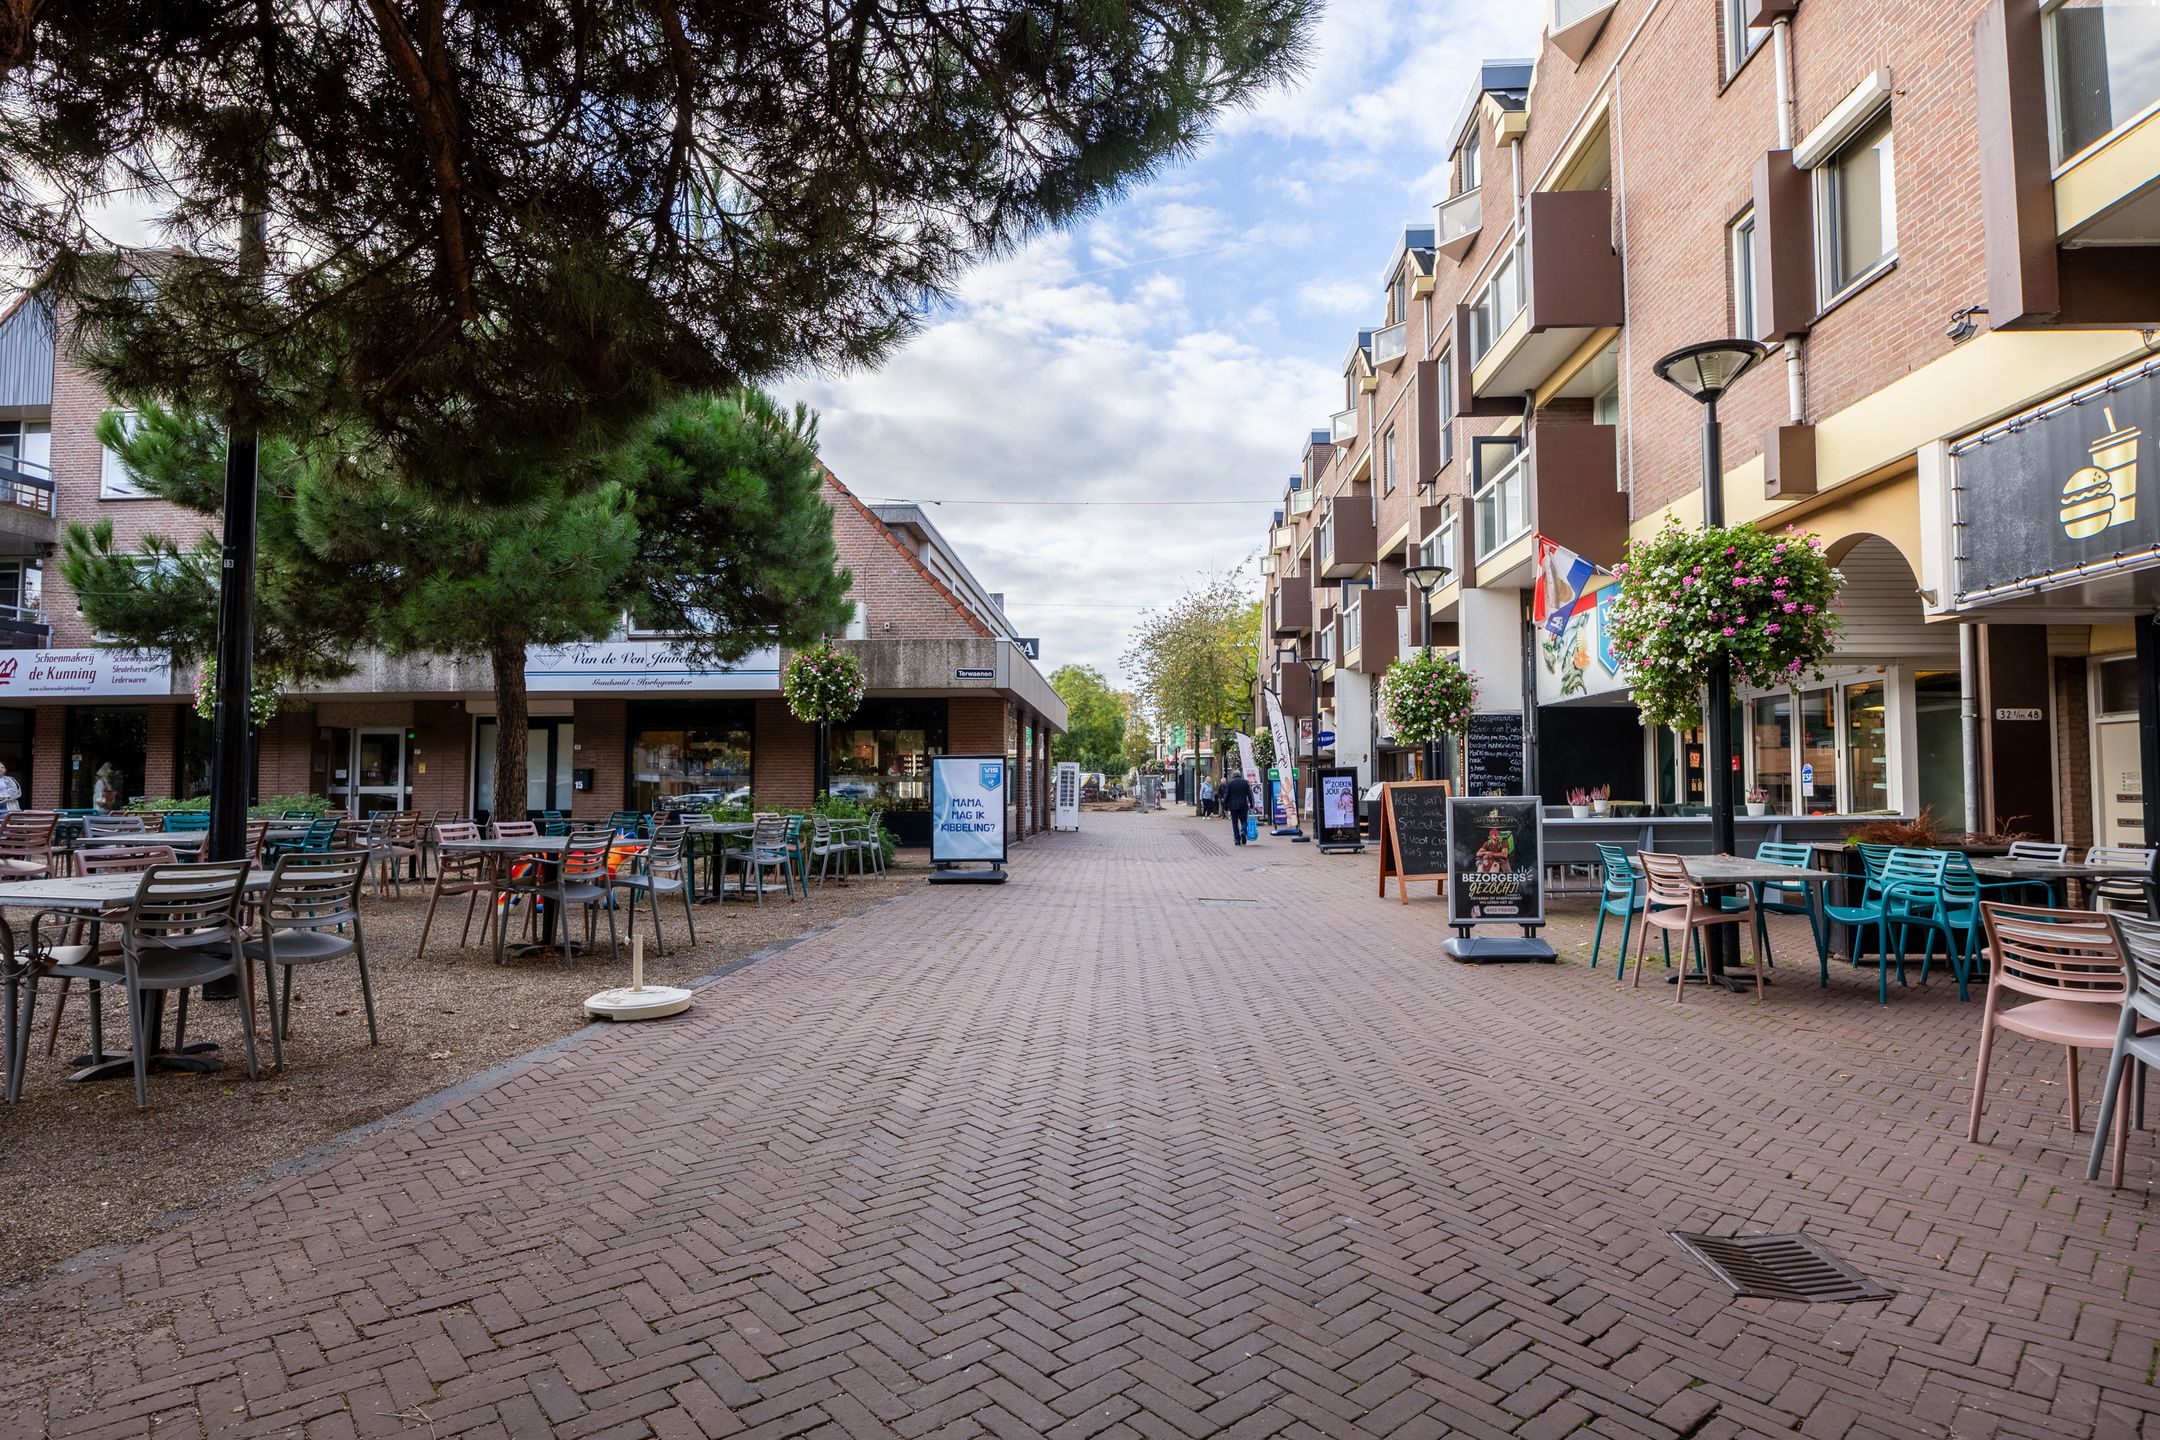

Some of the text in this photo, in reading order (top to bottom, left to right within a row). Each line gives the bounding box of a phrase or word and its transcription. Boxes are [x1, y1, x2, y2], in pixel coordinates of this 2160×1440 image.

[35, 652, 95, 665] Schoenmakerij
[572, 652, 597, 665] Van
[601, 652, 616, 664] de
[620, 652, 645, 664] Ven
[112, 665, 153, 673] Sleutelservice
[29, 666, 97, 684] de Kunning
[112, 675, 147, 684] Lederwaren
[592, 678, 629, 687] Goudsmid
[636, 678, 692, 688] Horlogemaker
[2000, 710, 2011, 719] 32
[2028, 710, 2039, 719] 48
[1363, 753, 1368, 763] 9
[575, 781, 583, 789] 15
[951, 810, 985, 820] MAG IK
[940, 823, 996, 832] KIBBELING?
[1462, 873, 1526, 882] BEZORGERS
